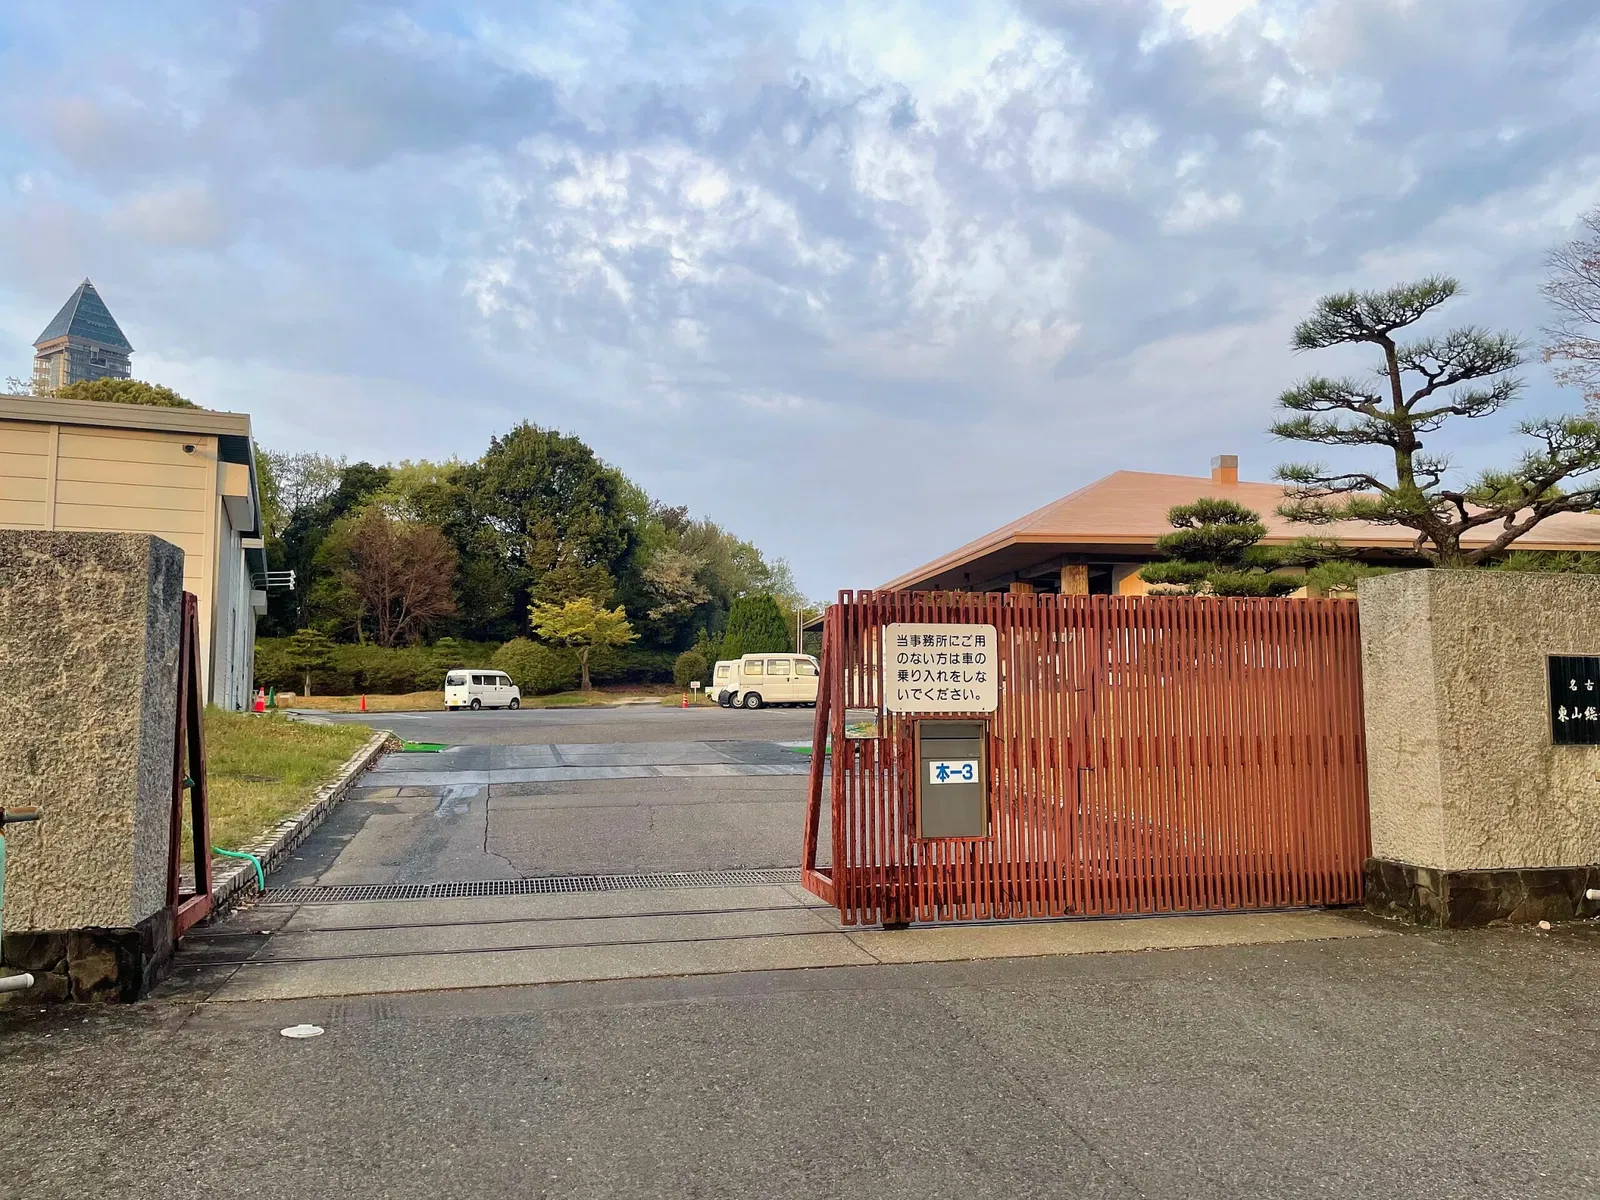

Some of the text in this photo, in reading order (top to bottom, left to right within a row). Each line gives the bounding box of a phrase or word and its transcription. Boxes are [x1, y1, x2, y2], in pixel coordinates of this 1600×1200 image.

[897, 634, 986, 647] 当事務所にご用
[897, 652, 987, 665] のない方は車の
[897, 669, 987, 683] 乗り入れをしな
[897, 687, 982, 701] いでください。
[1557, 705, 1600, 722] 東山総
